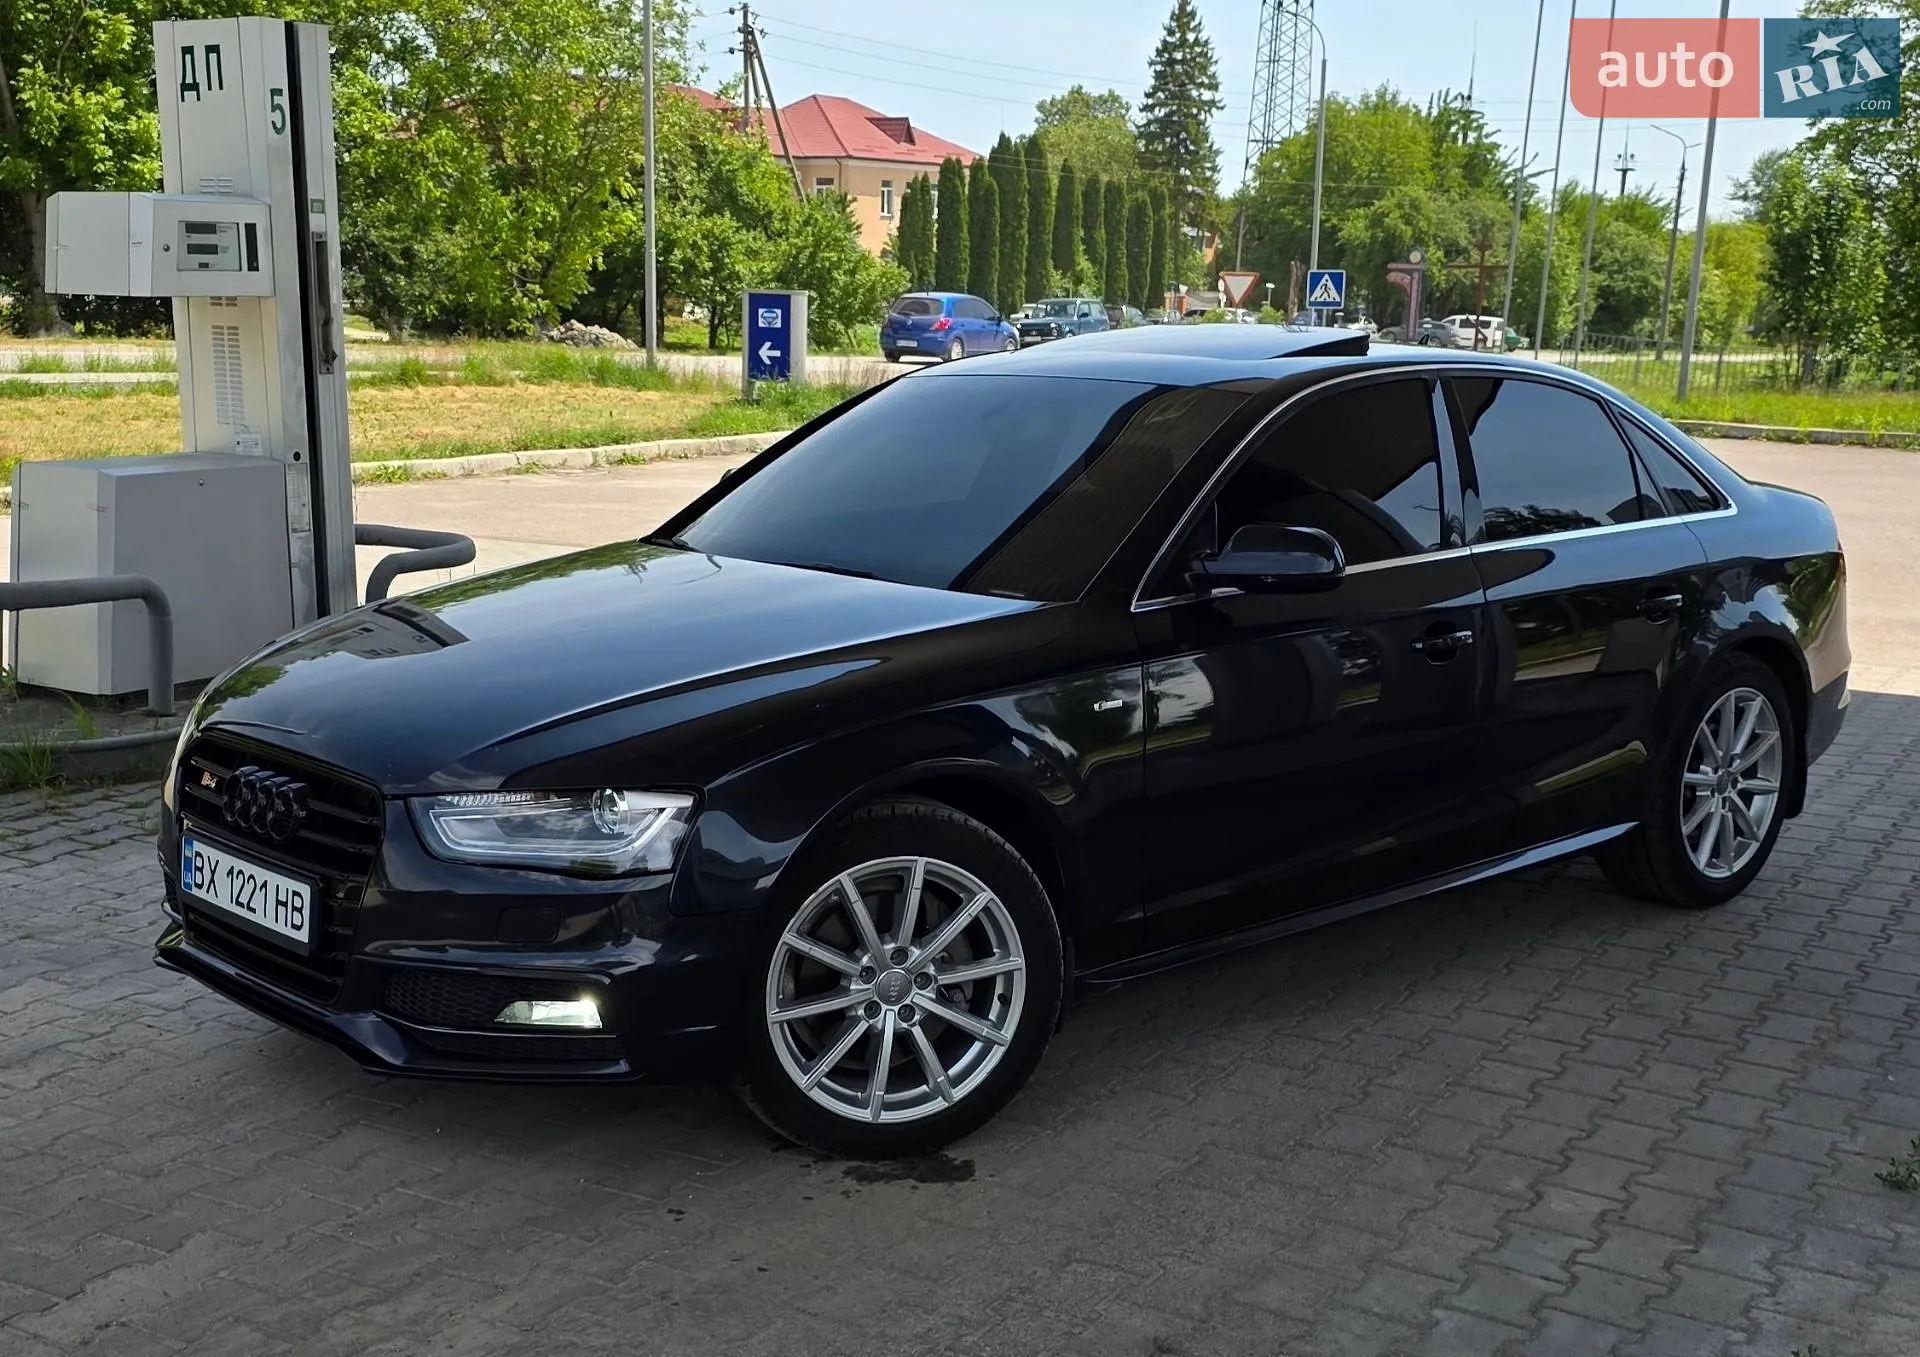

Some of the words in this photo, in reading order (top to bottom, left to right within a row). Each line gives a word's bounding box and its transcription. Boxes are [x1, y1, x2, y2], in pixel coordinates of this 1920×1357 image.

[180, 44, 224, 102] ДП
[269, 88, 287, 135] 5
[193, 850, 220, 898] BX
[226, 865, 268, 919] 1221
[274, 883, 305, 931] HB
